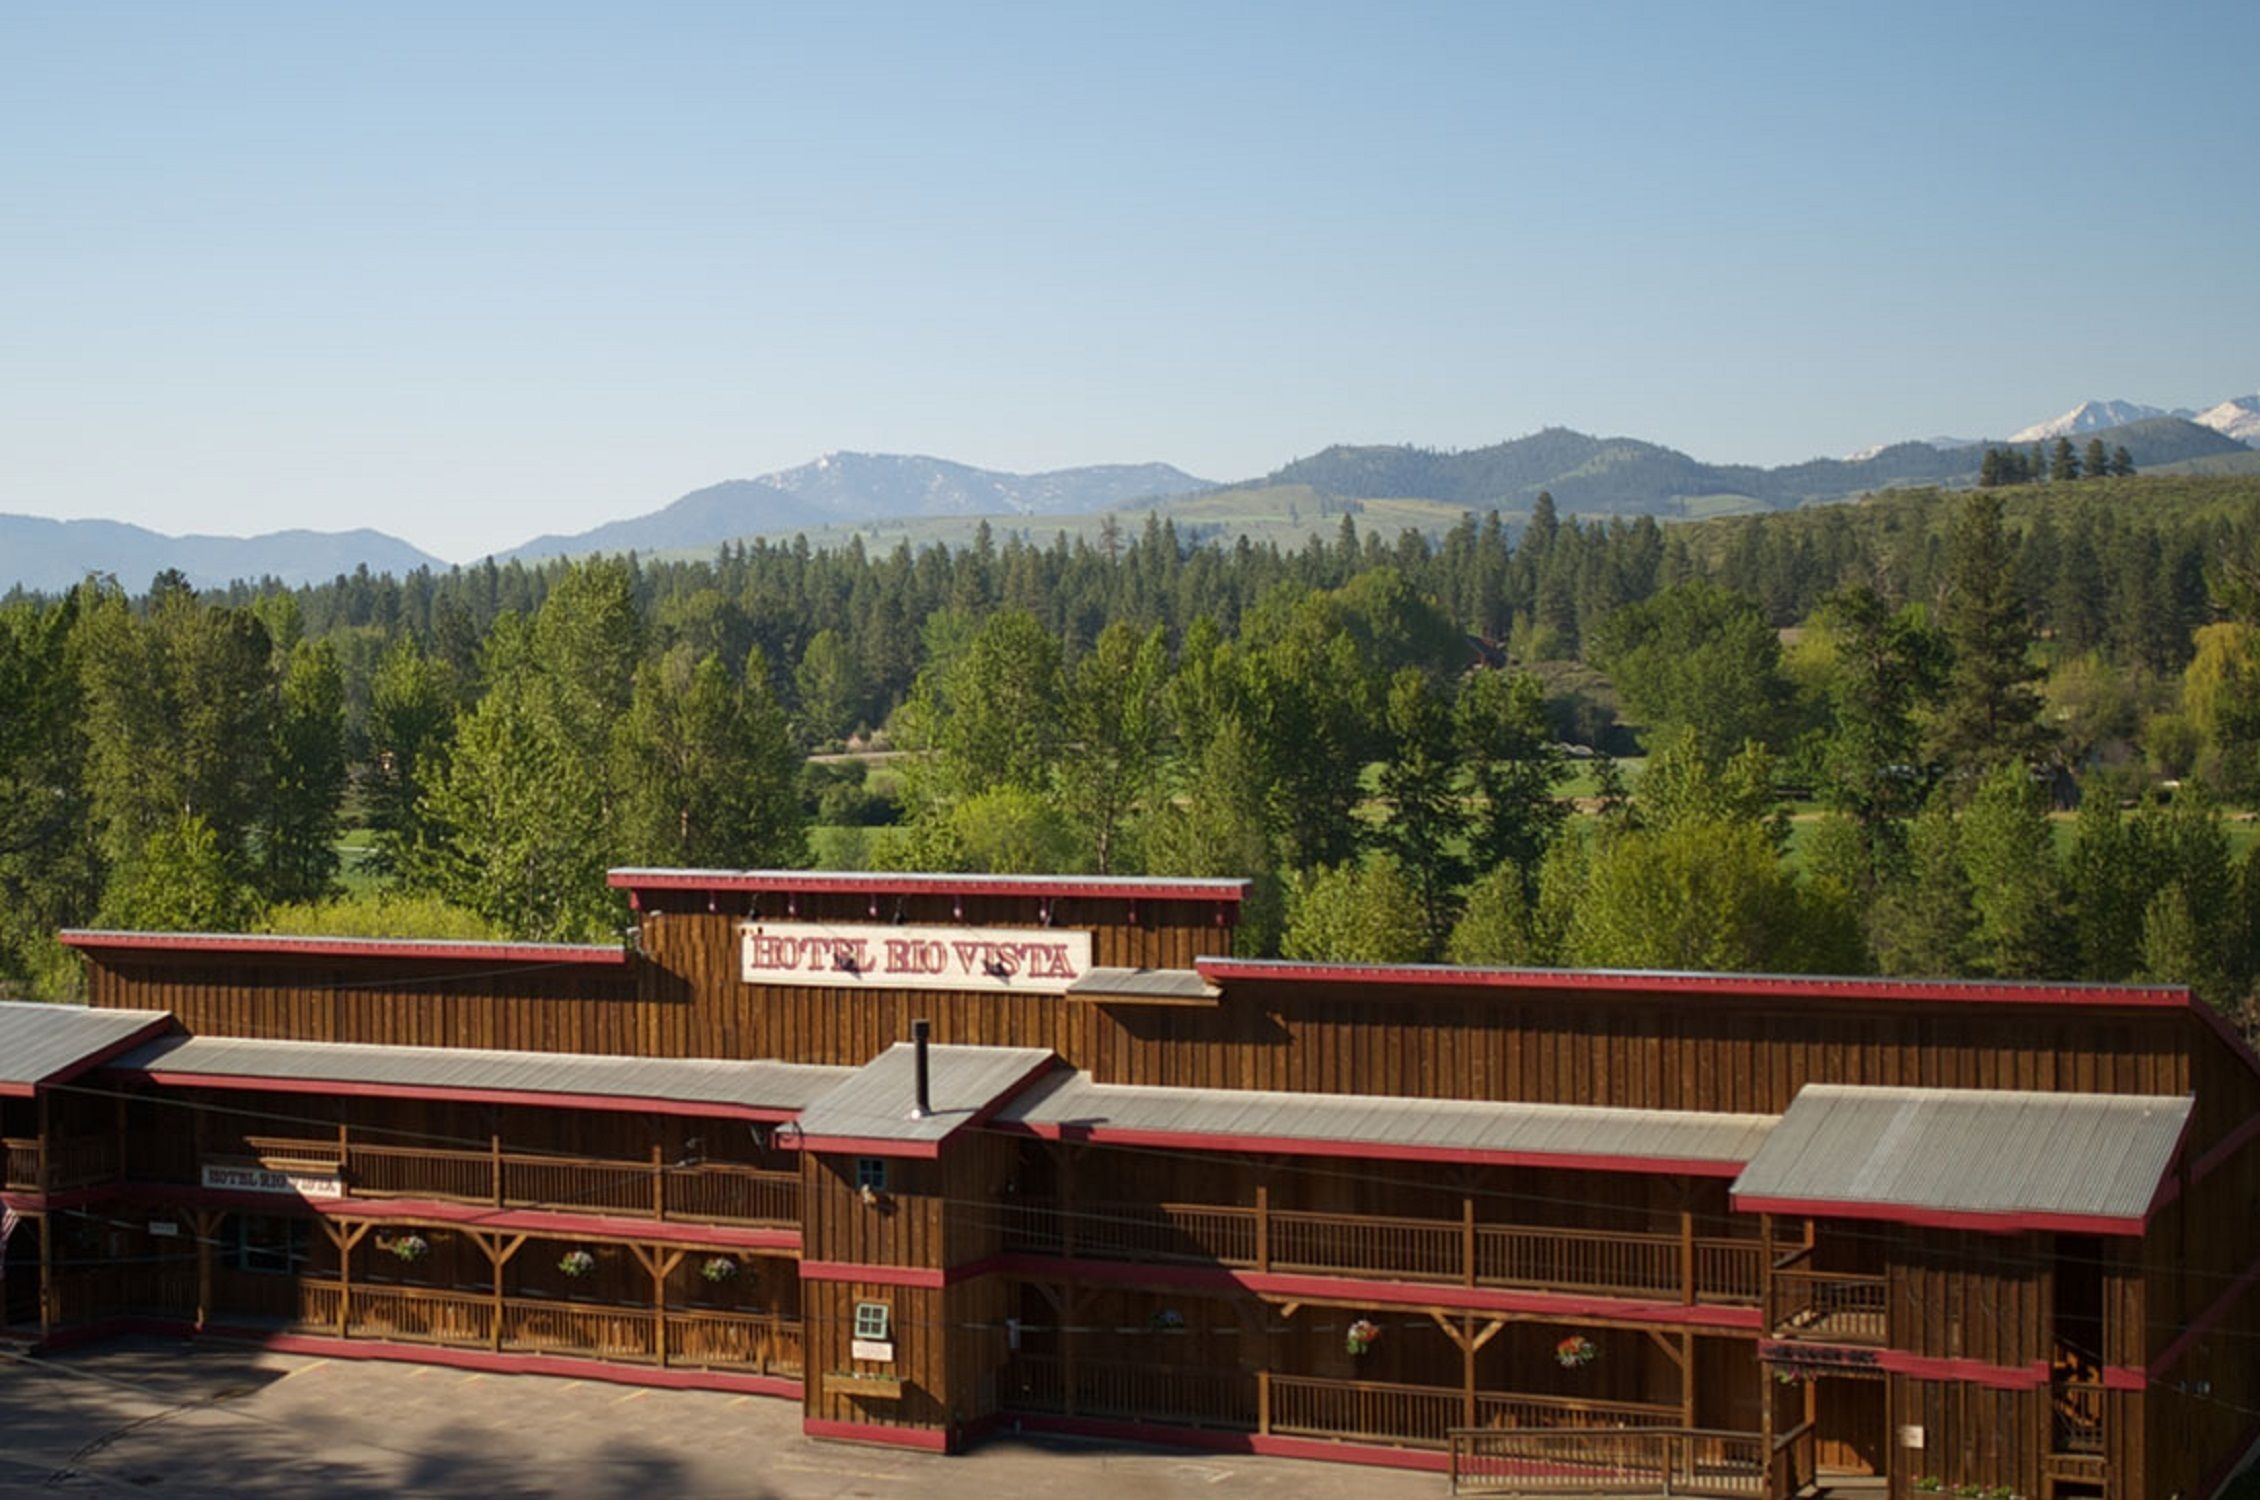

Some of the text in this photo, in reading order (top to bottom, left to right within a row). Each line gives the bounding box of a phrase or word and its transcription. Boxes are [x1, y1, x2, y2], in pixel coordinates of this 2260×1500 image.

[751, 935, 1078, 978] HOTEL RIO VISTA
